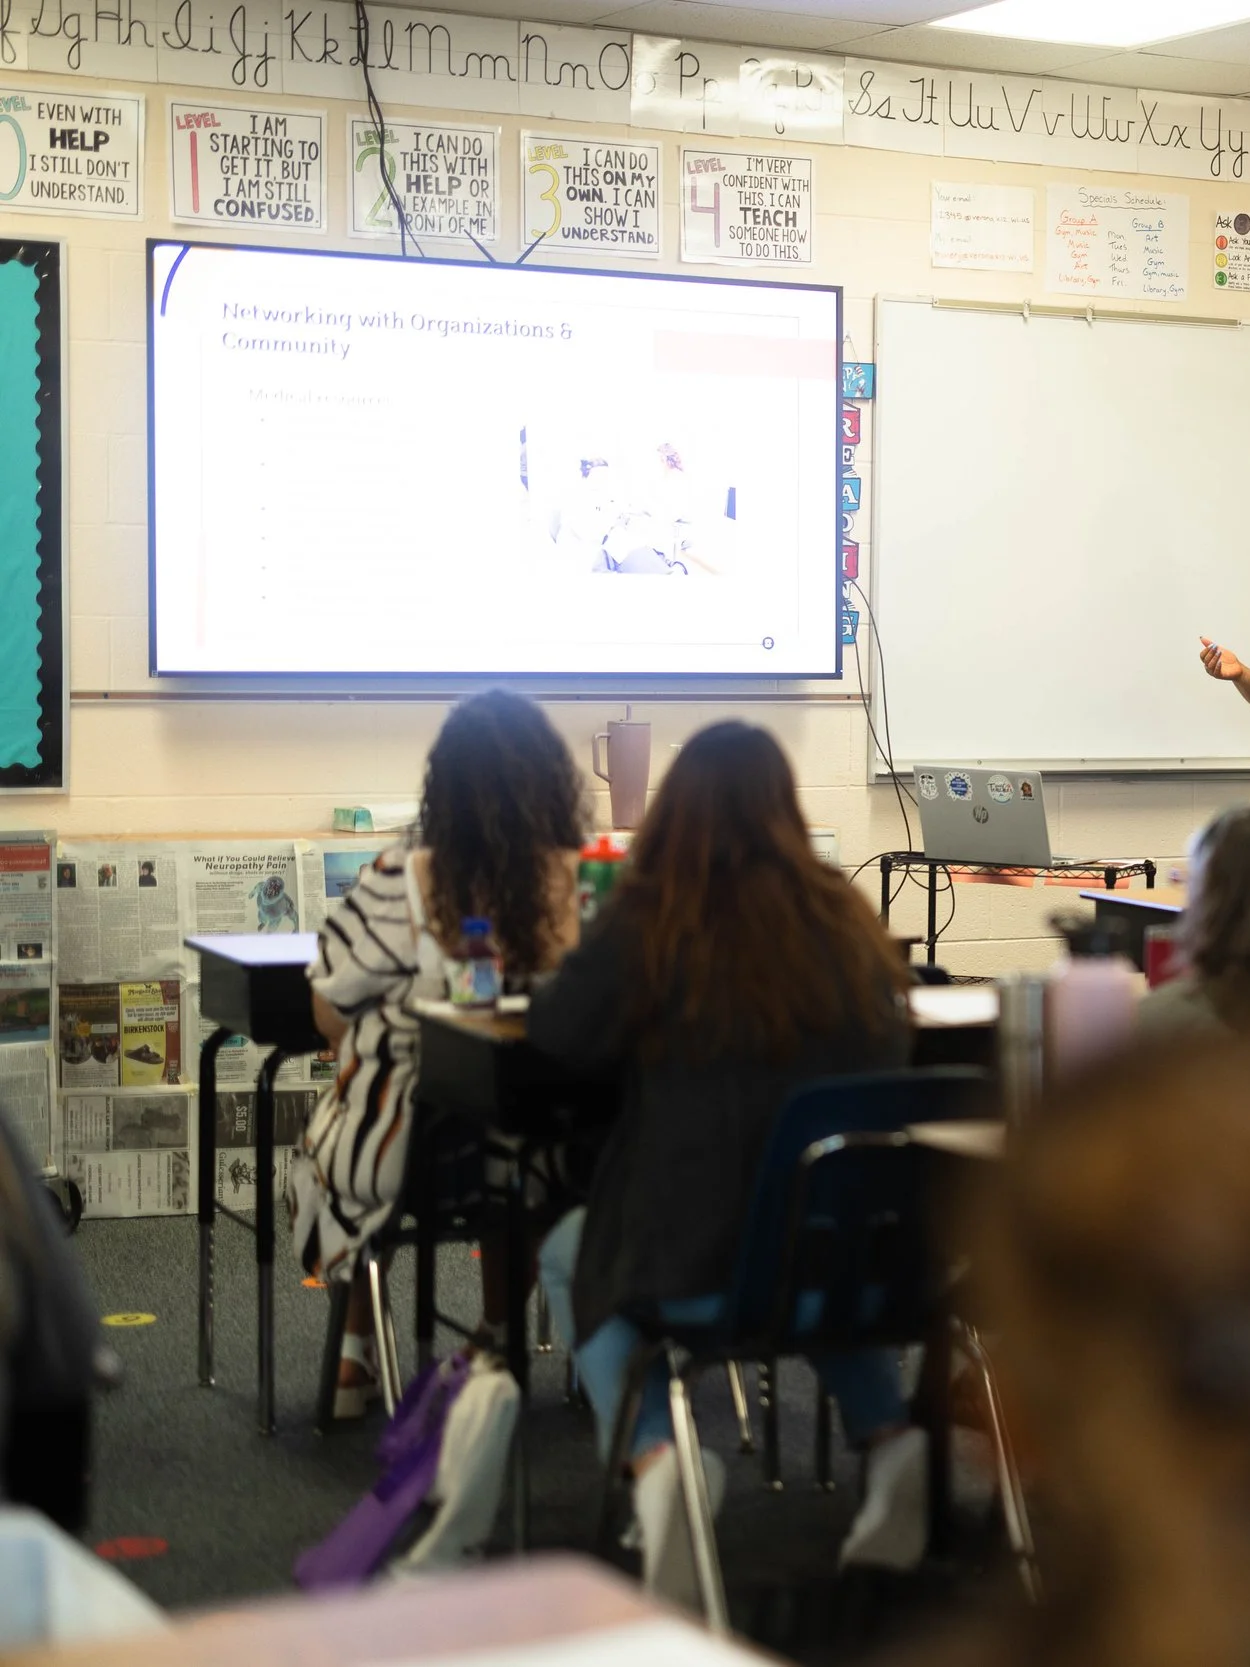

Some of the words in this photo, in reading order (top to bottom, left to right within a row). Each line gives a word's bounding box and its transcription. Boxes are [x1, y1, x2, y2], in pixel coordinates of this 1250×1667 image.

[38, 102, 76, 121] EVEN
[80, 105, 122, 126] WITH
[176, 112, 221, 130] LEVEL
[250, 115, 258, 134] I
[263, 116, 287, 137] AM
[50, 127, 110, 152] HELP
[210, 133, 293, 159] STARTING
[299, 140, 319, 161] TO
[414, 133, 421, 151] I
[426, 133, 458, 154] CAN
[463, 136, 482, 156] DO
[528, 144, 568, 161] LEVEL
[583, 148, 590, 166] I
[595, 149, 624, 169] CAN
[630, 152, 648, 171] DO
[29, 154, 36, 171] I
[41, 155, 82, 175] STILL
[87, 158, 130, 178] DON'T
[220, 155, 249, 176] GET
[254, 158, 277, 180] IT,
[281, 161, 311, 181] BUT
[400, 152, 438, 173] THIS
[444, 155, 488, 177] WITH
[687, 157, 726, 174] LEVEL
[747, 157, 763, 172] I'M
[767, 160, 792, 174] VERY
[406, 174, 462, 196] HELP
[470, 179, 489, 198] OR
[563, 166, 599, 186] THIS
[603, 171, 626, 186] ON
[631, 173, 655, 188] MY
[723, 174, 778, 190] CONFIDENT
[781, 178, 809, 192] WITH
[31, 180, 129, 205] UNDERSTAND.
[223, 177, 231, 197] I
[236, 179, 260, 199] AM
[265, 181, 311, 203] STILL
[529, 164, 561, 238] 3
[566, 186, 607, 203] OWN.
[613, 188, 619, 205] I
[625, 189, 655, 208] CAN
[738, 191, 767, 207] THIS.
[770, 193, 775, 206] I
[778, 194, 800, 208] CAN
[214, 199, 319, 223] CONFUSED.
[413, 196, 469, 215] EXAMPLE
[476, 201, 492, 217] IN
[584, 206, 628, 227] SHOW
[633, 210, 640, 228] I
[691, 176, 720, 248] 4
[740, 207, 797, 228] TEACH
[1060, 210, 1086, 224] Group
[1089, 214, 1097, 224] A
[449, 218, 465, 234] OF
[470, 218, 487, 235] ME
[1215, 215, 1232, 229] Ask
[729, 226, 779, 242] SOMEONE
[783, 229, 807, 244] HOW
[740, 242, 753, 257] TO
[756, 243, 770, 258] DO
[222, 302, 353, 332] Networking
[359, 311, 405, 330] with
[410, 313, 556, 340] Organizations
[560, 322, 574, 340] &
[221, 331, 352, 361] Community
[205, 862, 264, 871] Neuropathy
[123, 1024, 165, 1034] BIRKENSTOCK
[235, 1105, 247, 1132] $5.00
